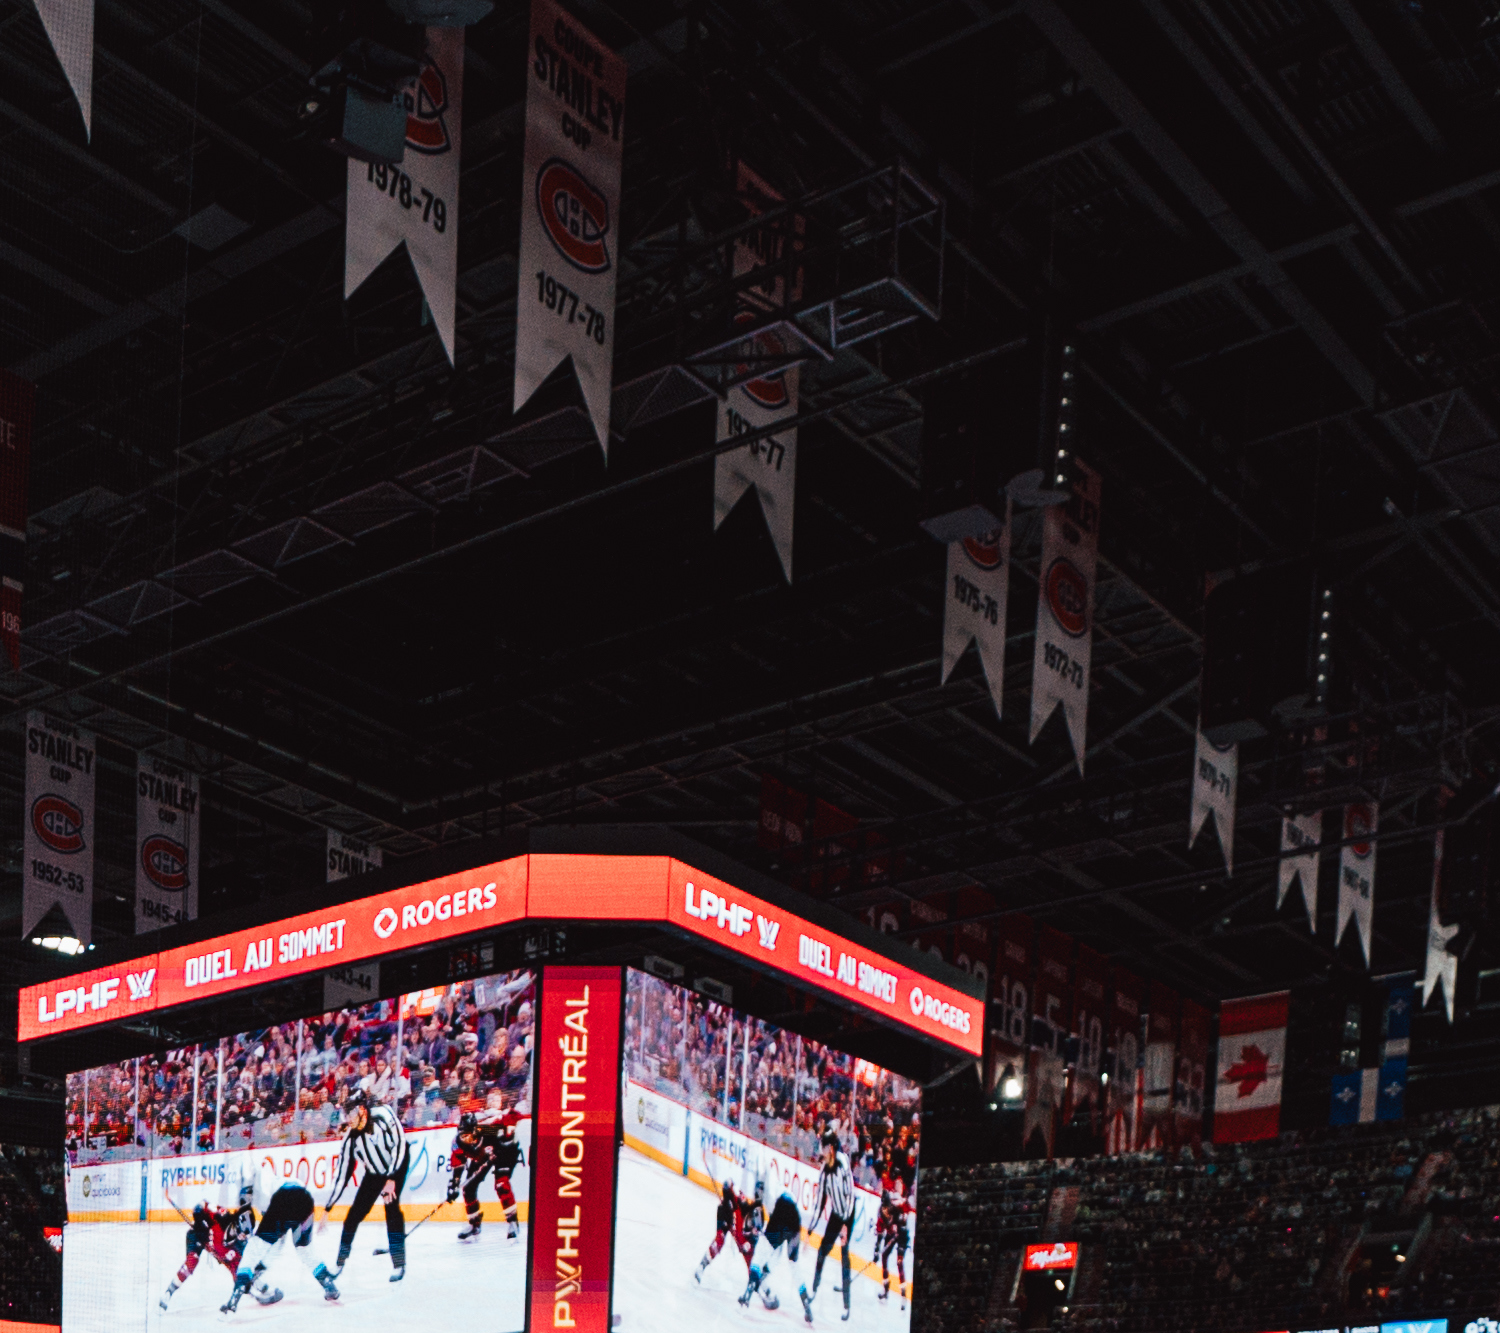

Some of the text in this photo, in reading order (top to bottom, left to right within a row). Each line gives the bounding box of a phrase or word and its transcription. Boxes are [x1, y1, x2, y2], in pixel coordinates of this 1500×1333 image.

[534, 36, 625, 142] STANLEY
[562, 113, 591, 150] CUP
[368, 163, 447, 233] 1978-79
[537, 271, 606, 345] 1977-78
[29, 727, 94, 774] STANLEY
[50, 765, 72, 783] CUP
[139, 772, 198, 814] STANLEY
[32, 859, 84, 893] 1952-53
[402, 883, 497, 930] ROGERS
[685, 882, 753, 936] LPHF
[185, 919, 346, 987] DUEL AU SOMMET
[799, 934, 898, 1004] DUEL AU SOMMET
[38, 978, 120, 1022] LPHF
[925, 995, 970, 1034] ROGERS
[554, 985, 590, 1328] PWHL MONTRÉAL
